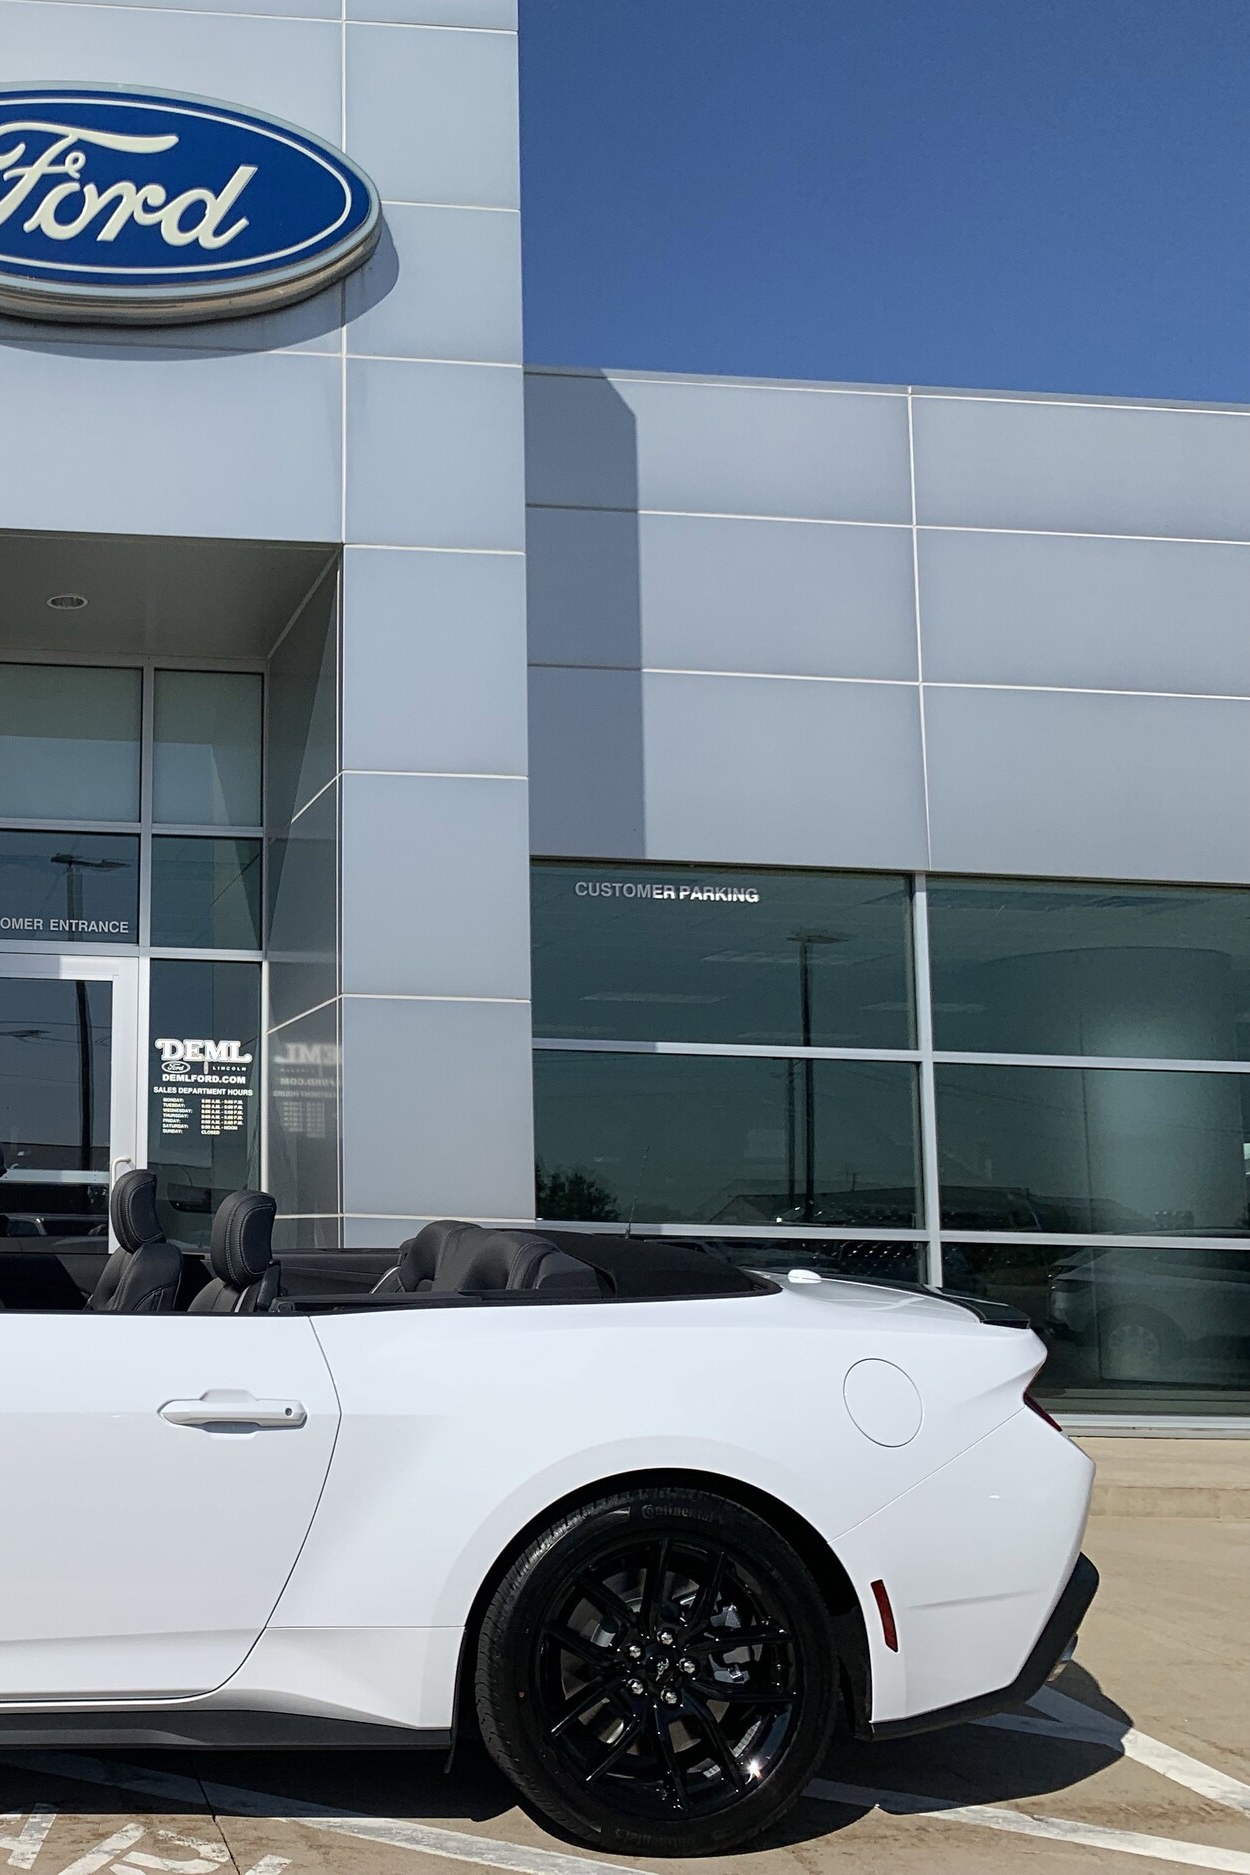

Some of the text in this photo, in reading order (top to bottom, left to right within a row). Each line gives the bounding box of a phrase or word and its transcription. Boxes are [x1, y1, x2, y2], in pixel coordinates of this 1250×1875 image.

[575, 881, 760, 903] CUSTOMER PARKING
[49, 918, 129, 933] ENTRANCE
[154, 1038, 253, 1064] DEML
[161, 1073, 246, 1084] DEMLFORD.COM
[153, 1086, 253, 1097] SALES DEPARTMENT HOURS
